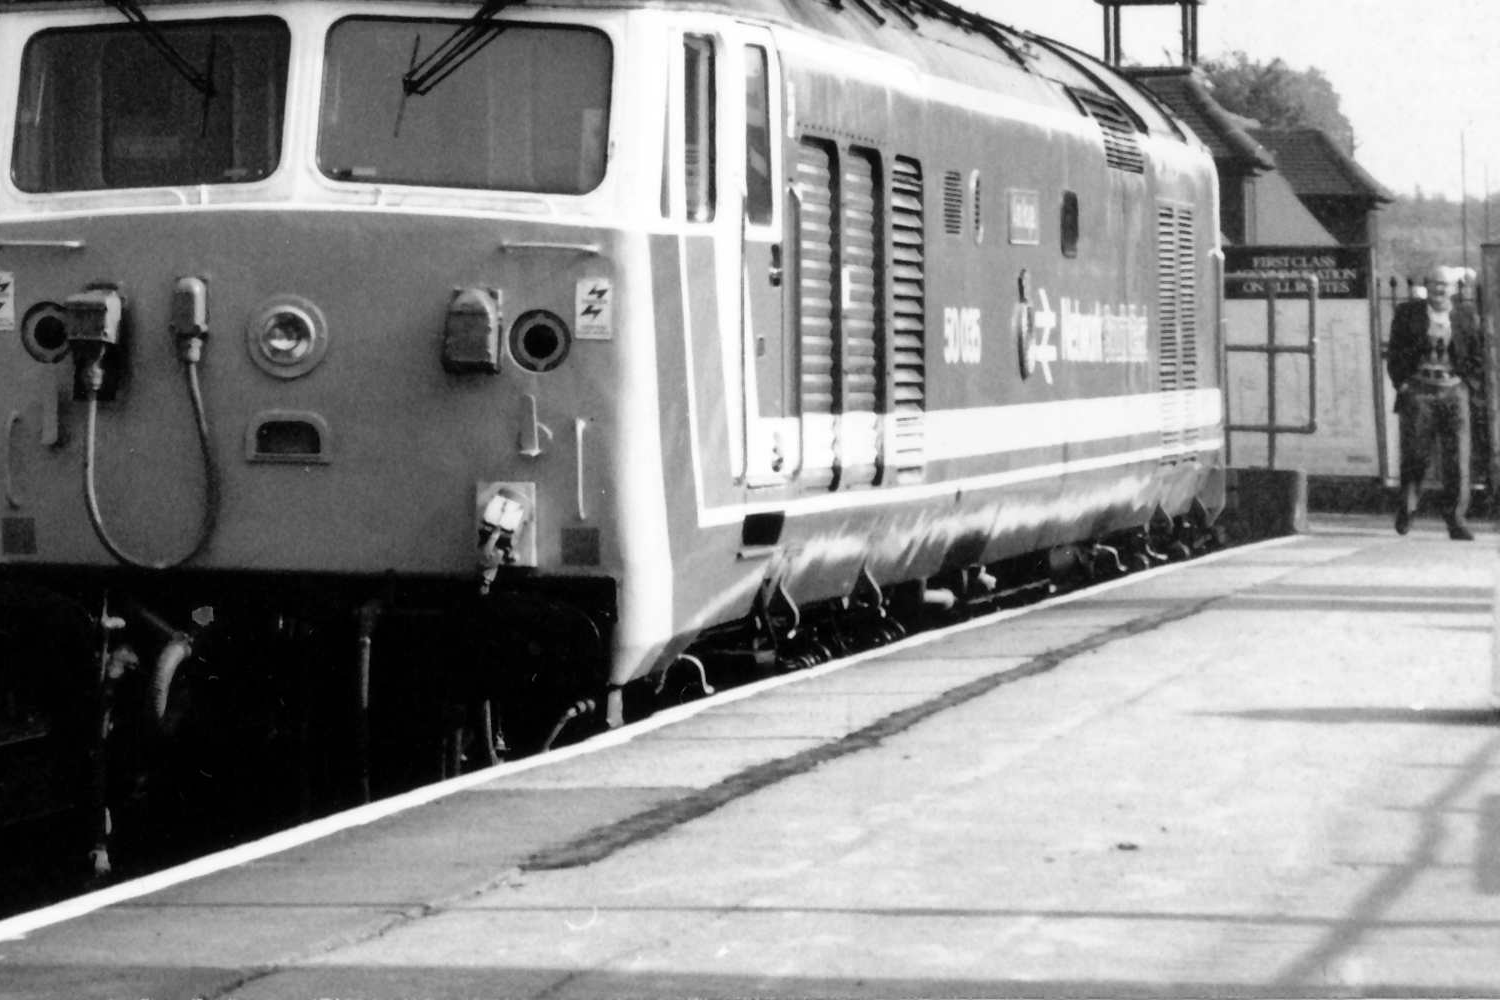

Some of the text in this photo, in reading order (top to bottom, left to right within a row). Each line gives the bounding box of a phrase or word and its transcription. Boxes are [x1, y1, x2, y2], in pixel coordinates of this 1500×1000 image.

[1252, 256, 1337, 268] FIRST CLASS
[1242, 281, 1264, 293] ON
